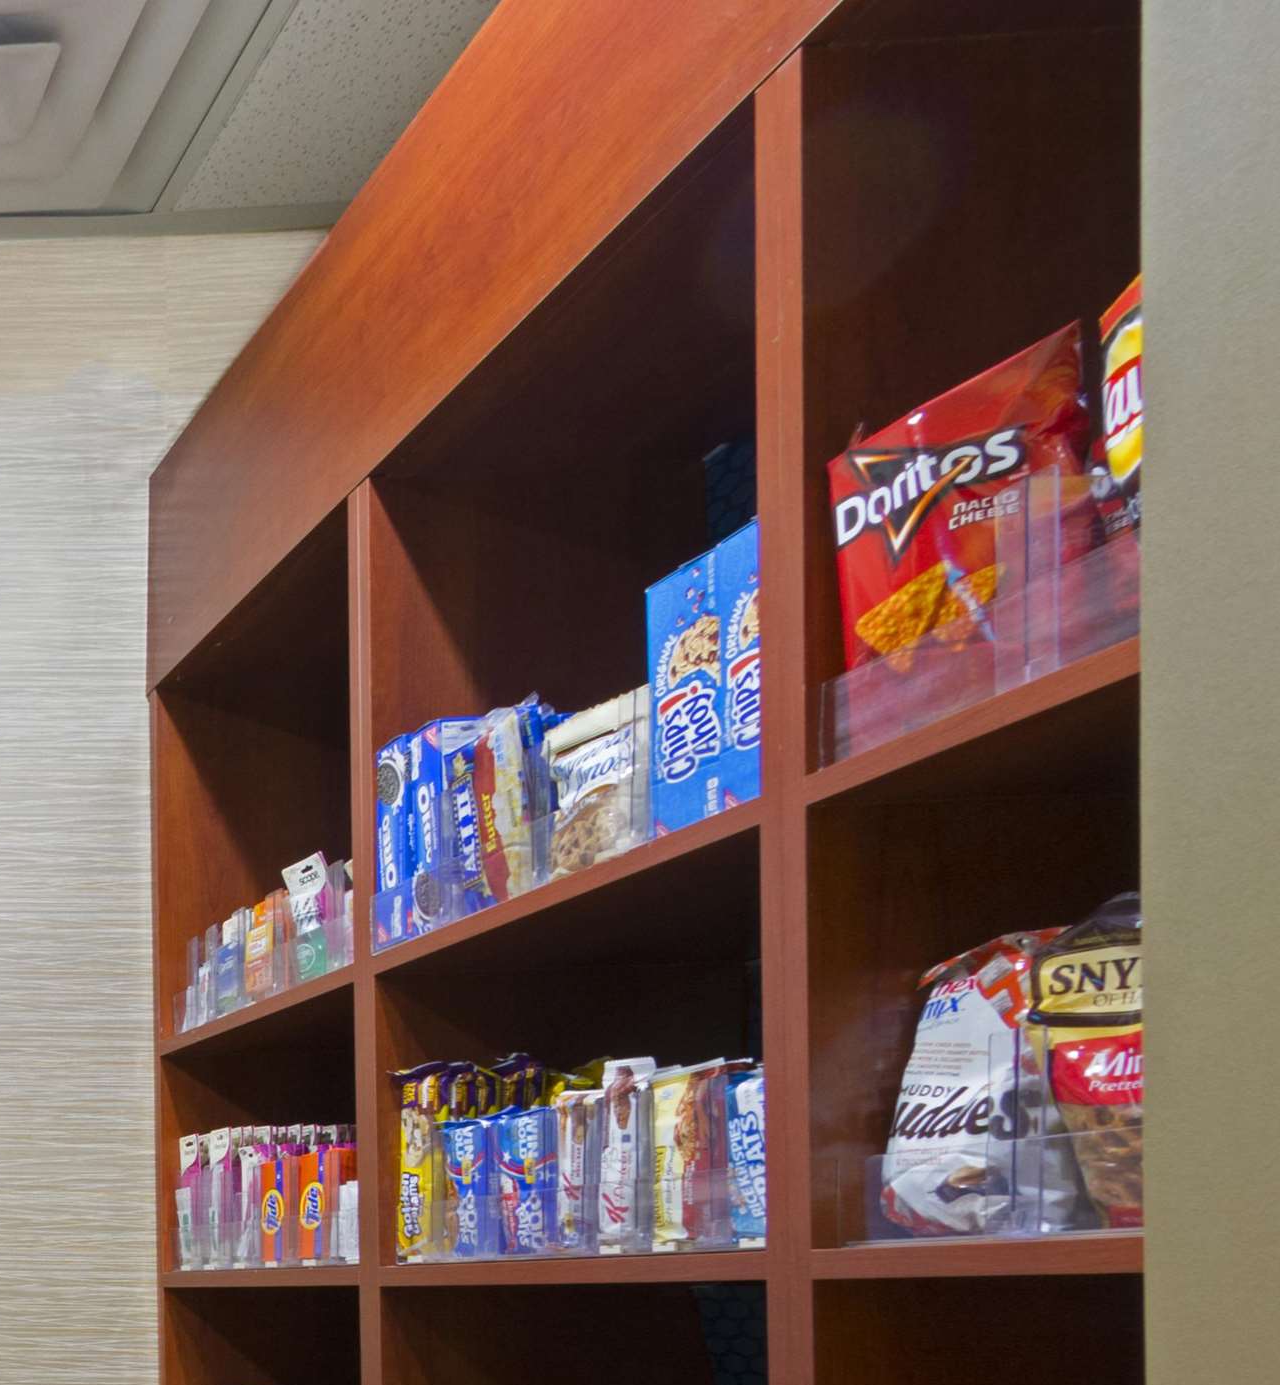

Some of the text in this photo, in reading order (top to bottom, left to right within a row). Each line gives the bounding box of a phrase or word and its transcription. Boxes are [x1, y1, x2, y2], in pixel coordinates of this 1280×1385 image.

[837, 429, 1020, 545] Doritos
[948, 499, 1020, 531] CHEESE
[655, 633, 678, 697] ORIGINAL
[662, 708, 698, 780] Chips
[482, 793, 498, 852] Butter
[381, 815, 398, 888] OREO
[1049, 957, 1145, 997] SNY
[890, 1086, 1032, 1141] uddies
[263, 1194, 279, 1231] Tide
[304, 1186, 322, 1225] Tide
